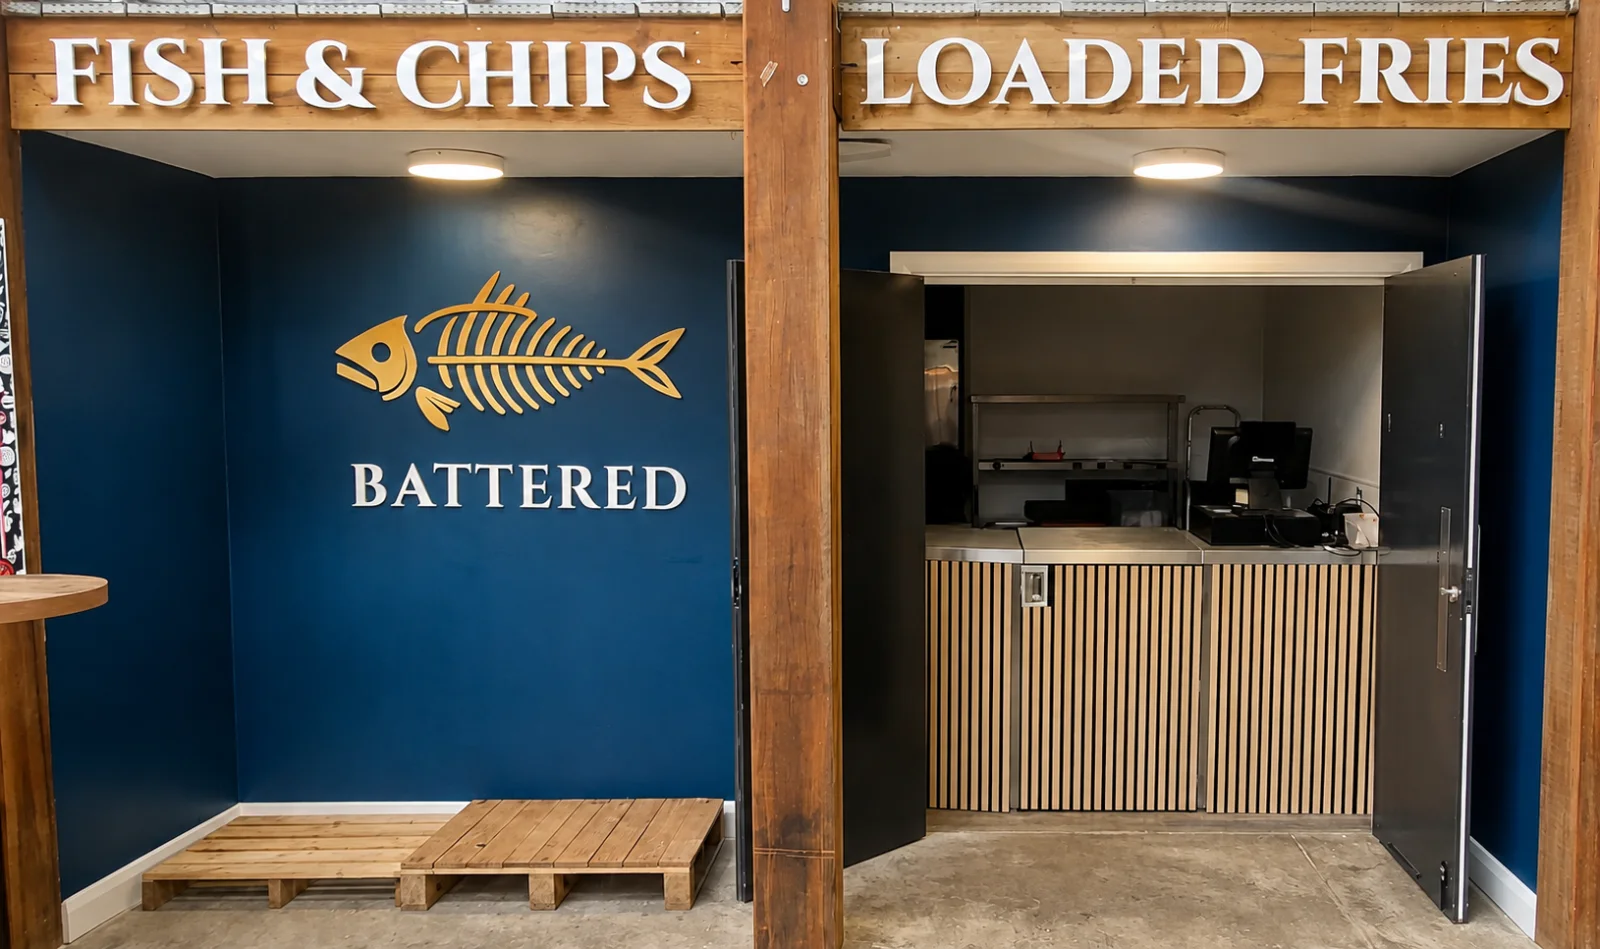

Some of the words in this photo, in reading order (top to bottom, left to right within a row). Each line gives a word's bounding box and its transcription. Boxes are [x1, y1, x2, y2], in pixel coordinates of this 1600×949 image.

[49, 37, 273, 107] FISH
[295, 39, 377, 109] &
[396, 39, 692, 110] CHIPS
[861, 37, 1264, 105] LOADED
[1299, 37, 1564, 106] FRIES
[351, 463, 687, 510] BATTERED
